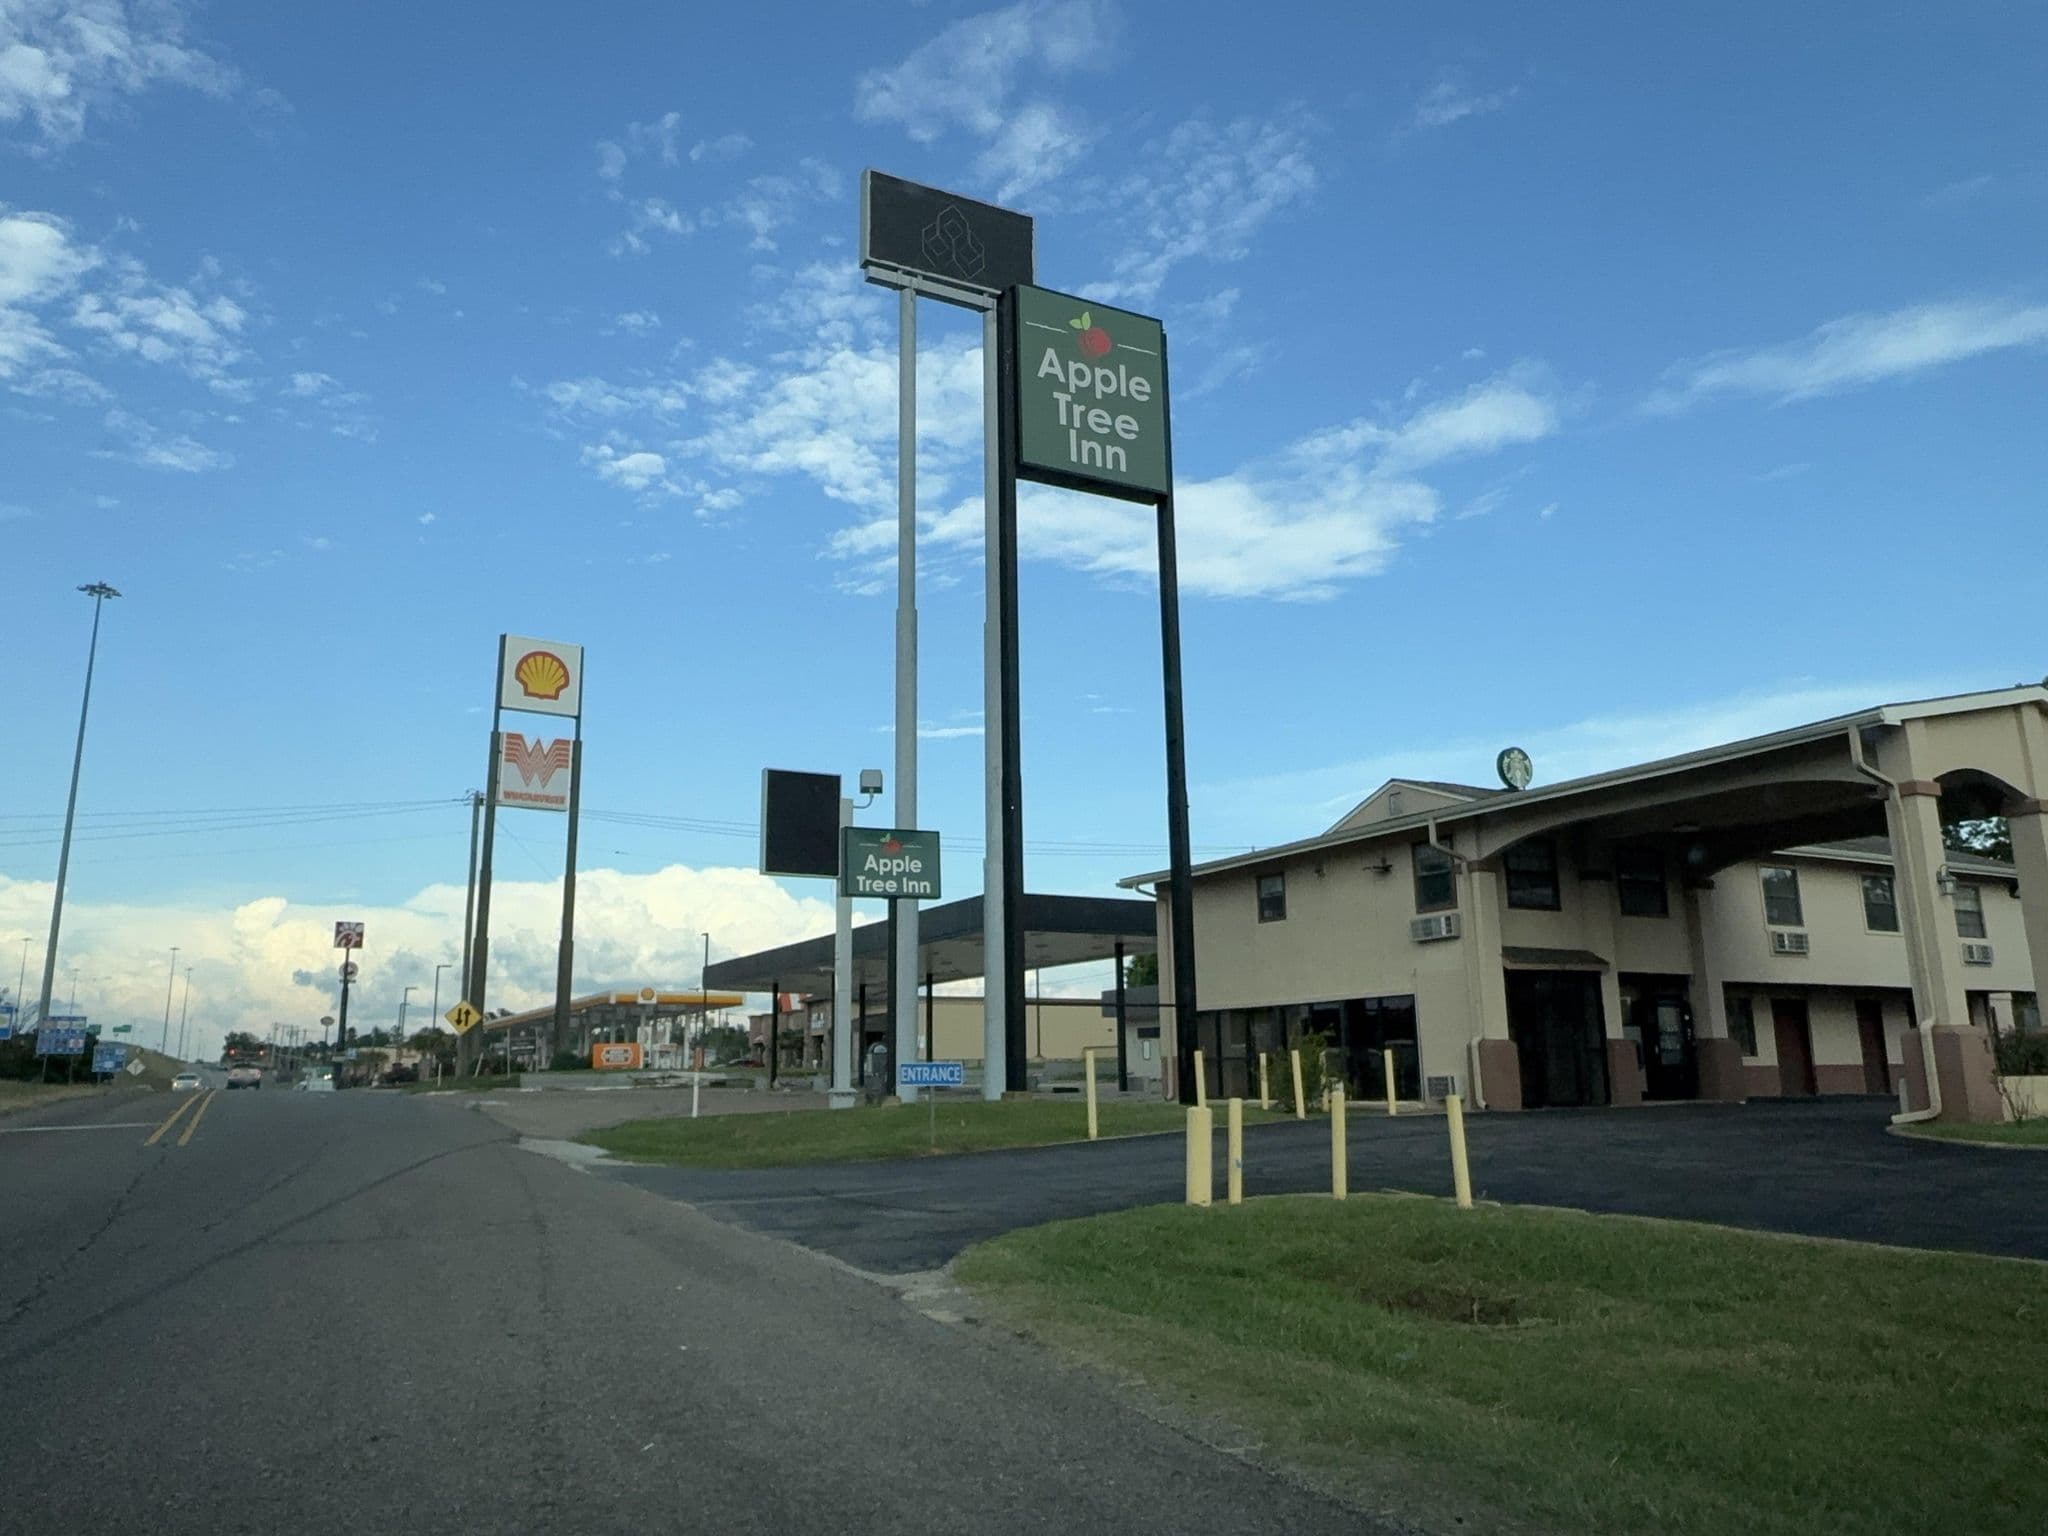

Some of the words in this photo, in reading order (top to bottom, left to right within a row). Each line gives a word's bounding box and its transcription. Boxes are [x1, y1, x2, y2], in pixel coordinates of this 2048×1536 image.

[1037, 347, 1151, 401] Apple
[1053, 391, 1139, 440] Tree
[1069, 428, 1126, 472] Inn
[864, 854, 922, 876] Apple
[856, 875, 898, 893] Tree
[902, 877, 931, 894] Inn
[901, 1066, 961, 1082] ENTRANCE
